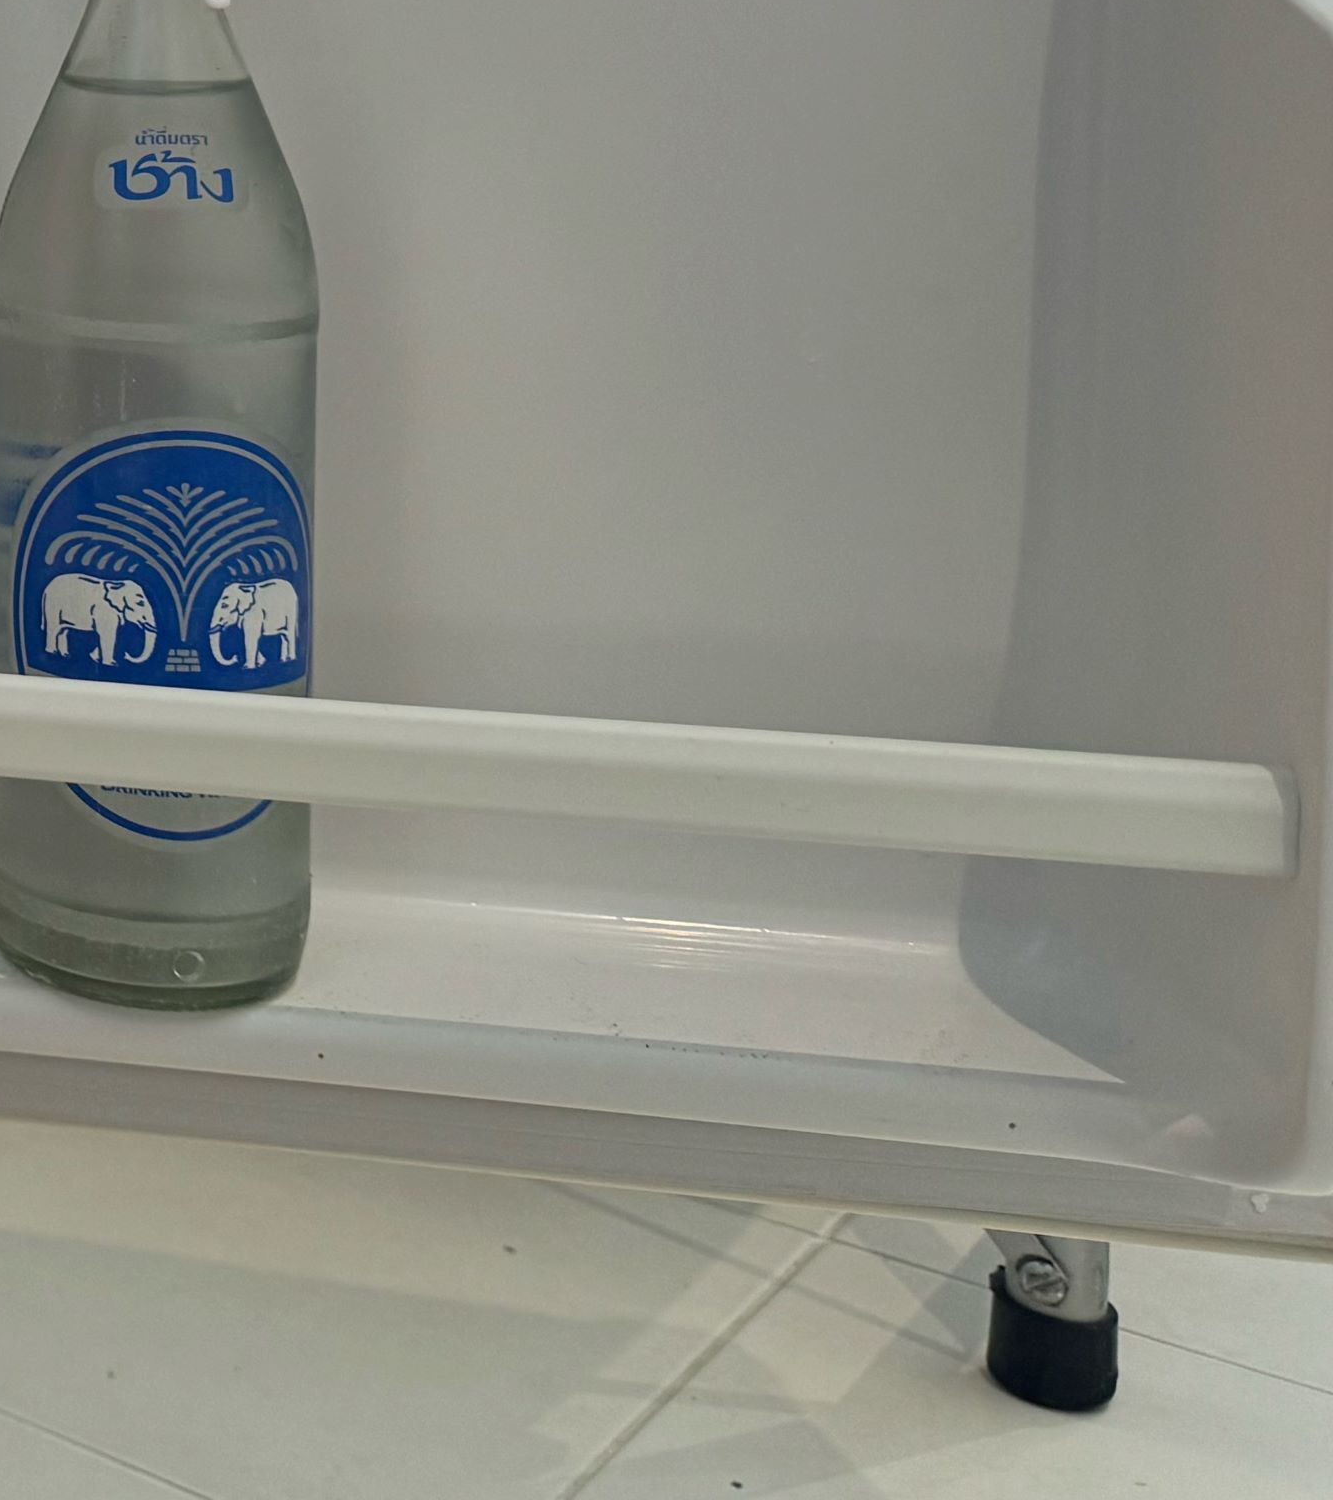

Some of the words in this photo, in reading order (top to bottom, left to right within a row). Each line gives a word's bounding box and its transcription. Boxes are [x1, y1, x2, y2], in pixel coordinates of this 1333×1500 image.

[135, 126, 208, 146] น้ำดื่มตรา
[109, 150, 234, 203] ช้าง
